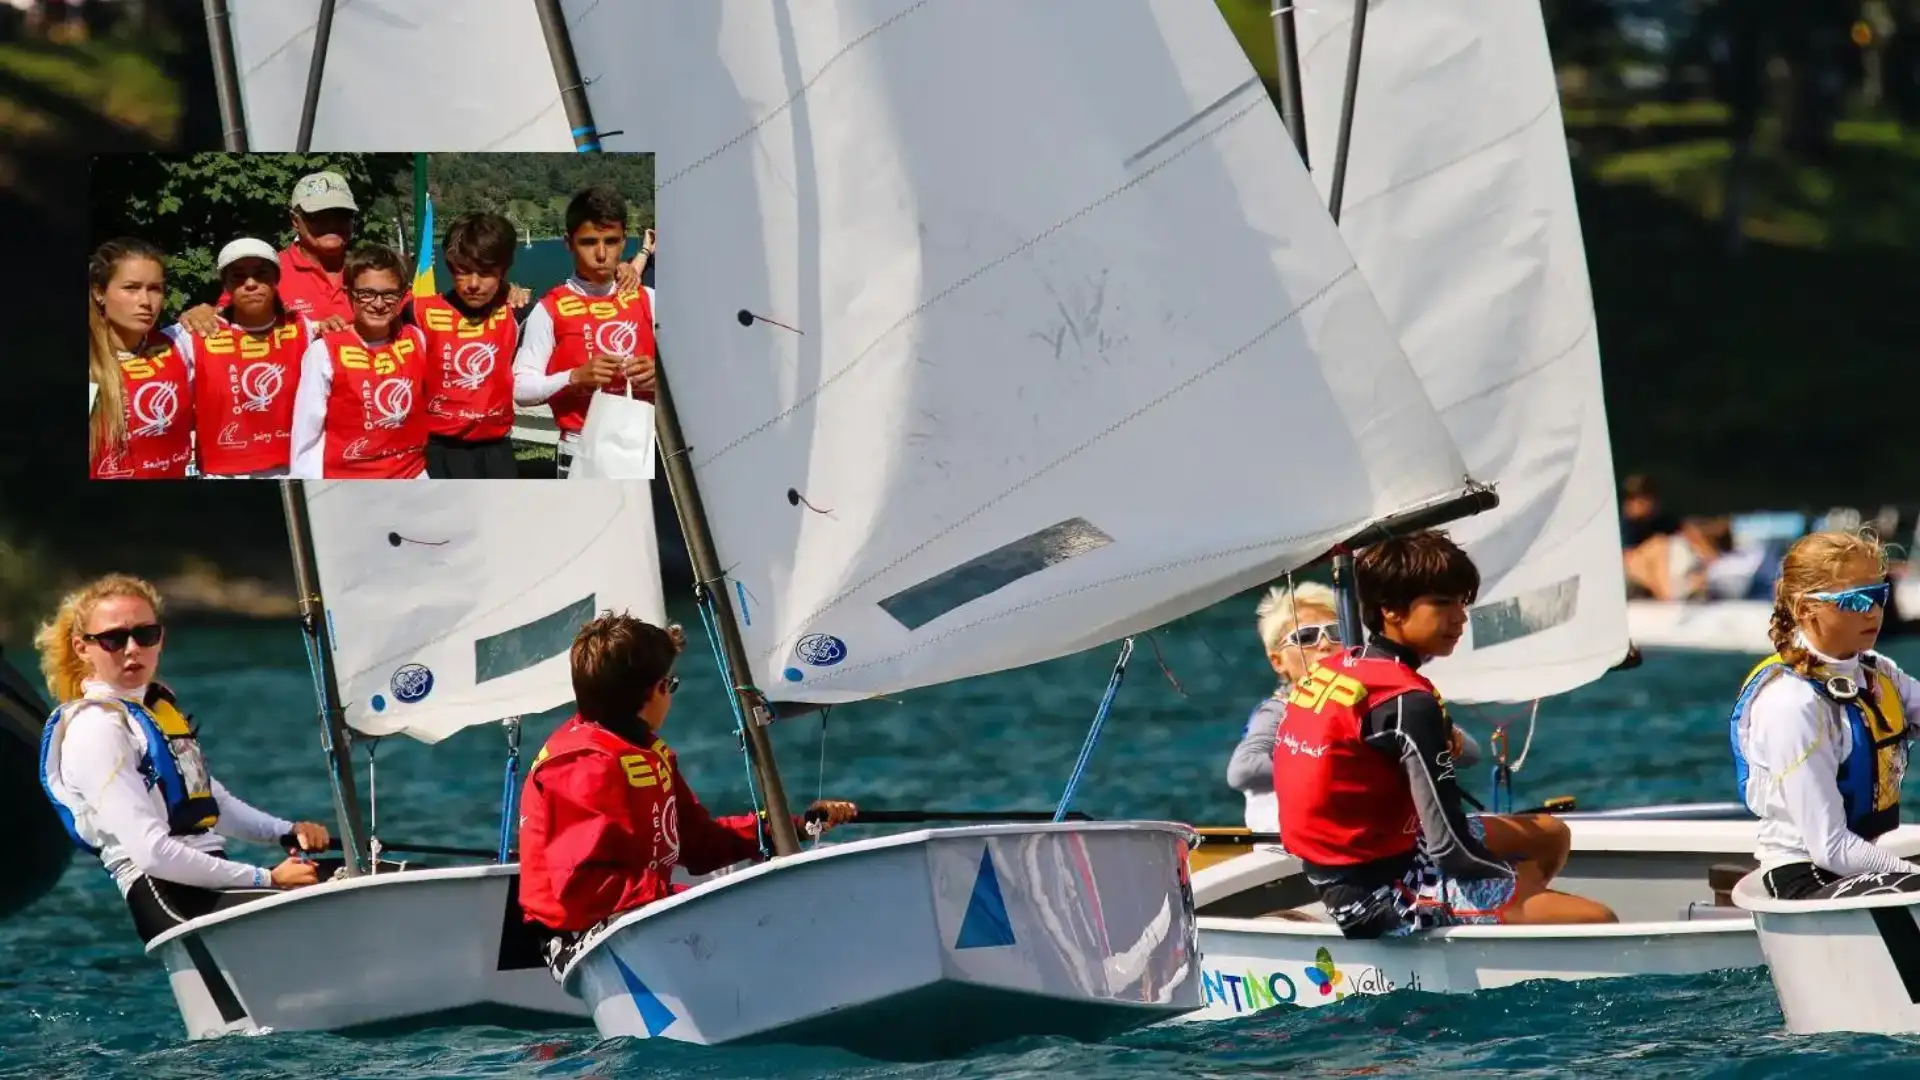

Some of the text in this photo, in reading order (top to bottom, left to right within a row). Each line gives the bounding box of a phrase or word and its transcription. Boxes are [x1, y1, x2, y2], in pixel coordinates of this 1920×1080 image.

[426, 304, 507, 339] ESP
[557, 289, 639, 319] ESP
[205, 325, 298, 359] ESP
[340, 338, 415, 375] ESP
[583, 323, 594, 361] AECI
[229, 364, 243, 416] AECIO
[362, 380, 373, 430] AECIO
[648, 801, 661, 870] AECIO
[1348, 967, 1422, 996] Valle di
